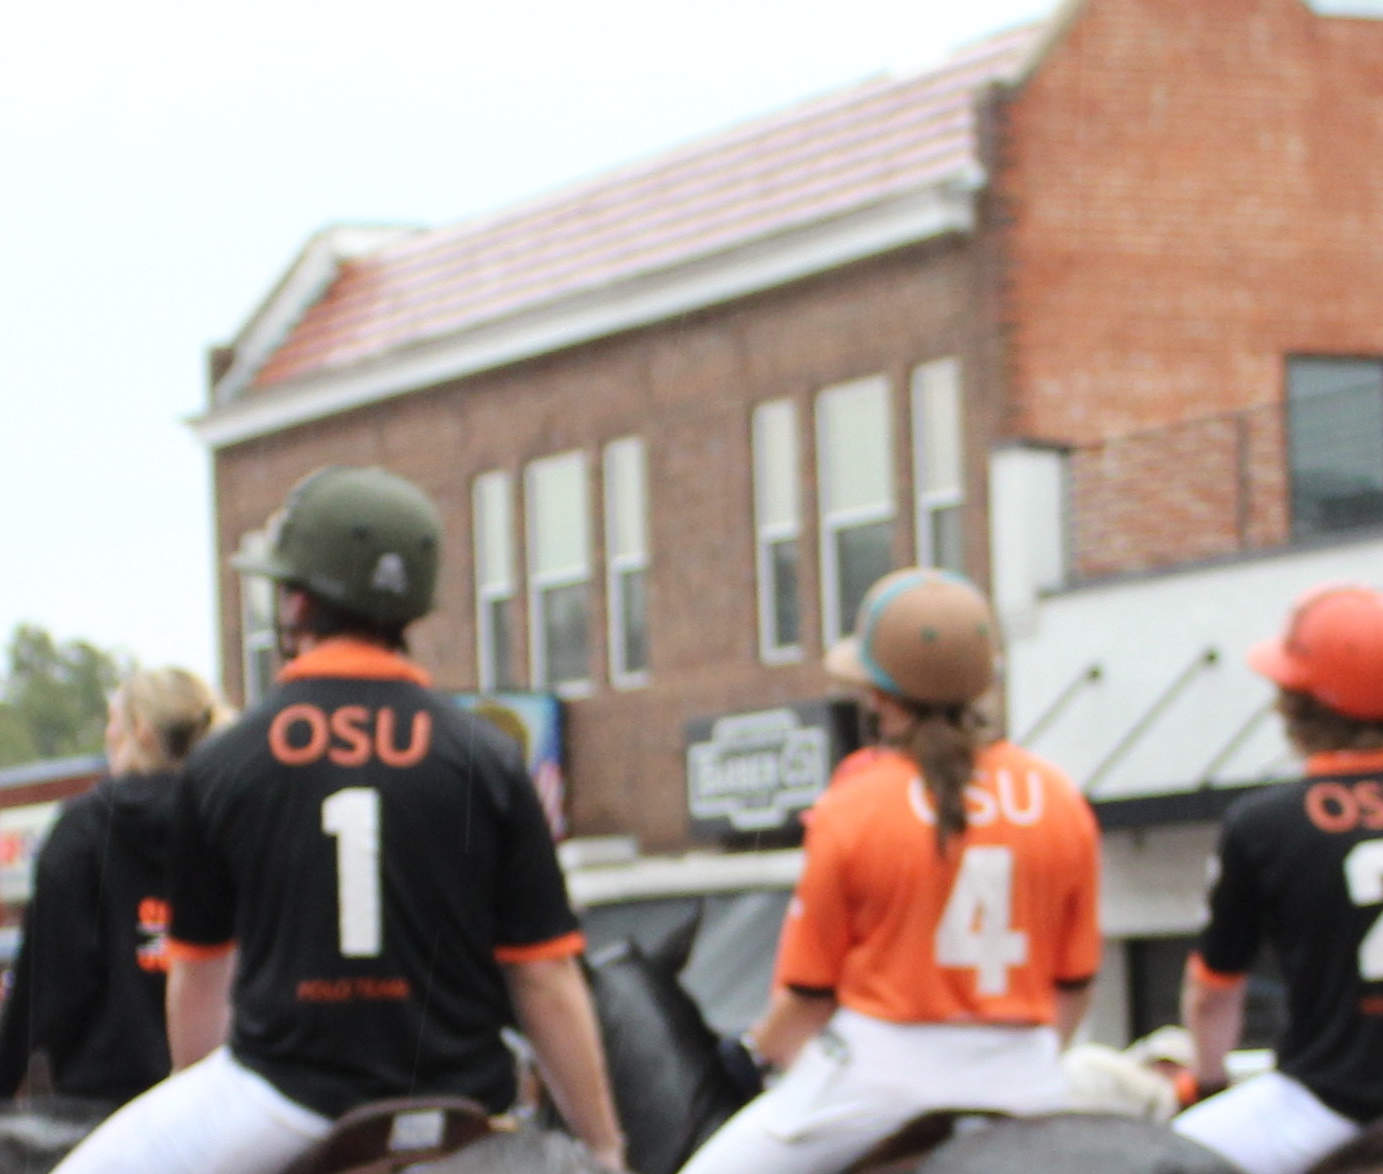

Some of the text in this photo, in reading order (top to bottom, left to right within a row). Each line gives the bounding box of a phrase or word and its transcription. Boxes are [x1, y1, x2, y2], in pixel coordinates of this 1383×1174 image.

[269, 703, 432, 767] OSU
[321, 786, 383, 959] 1
[935, 845, 1029, 996] 4
